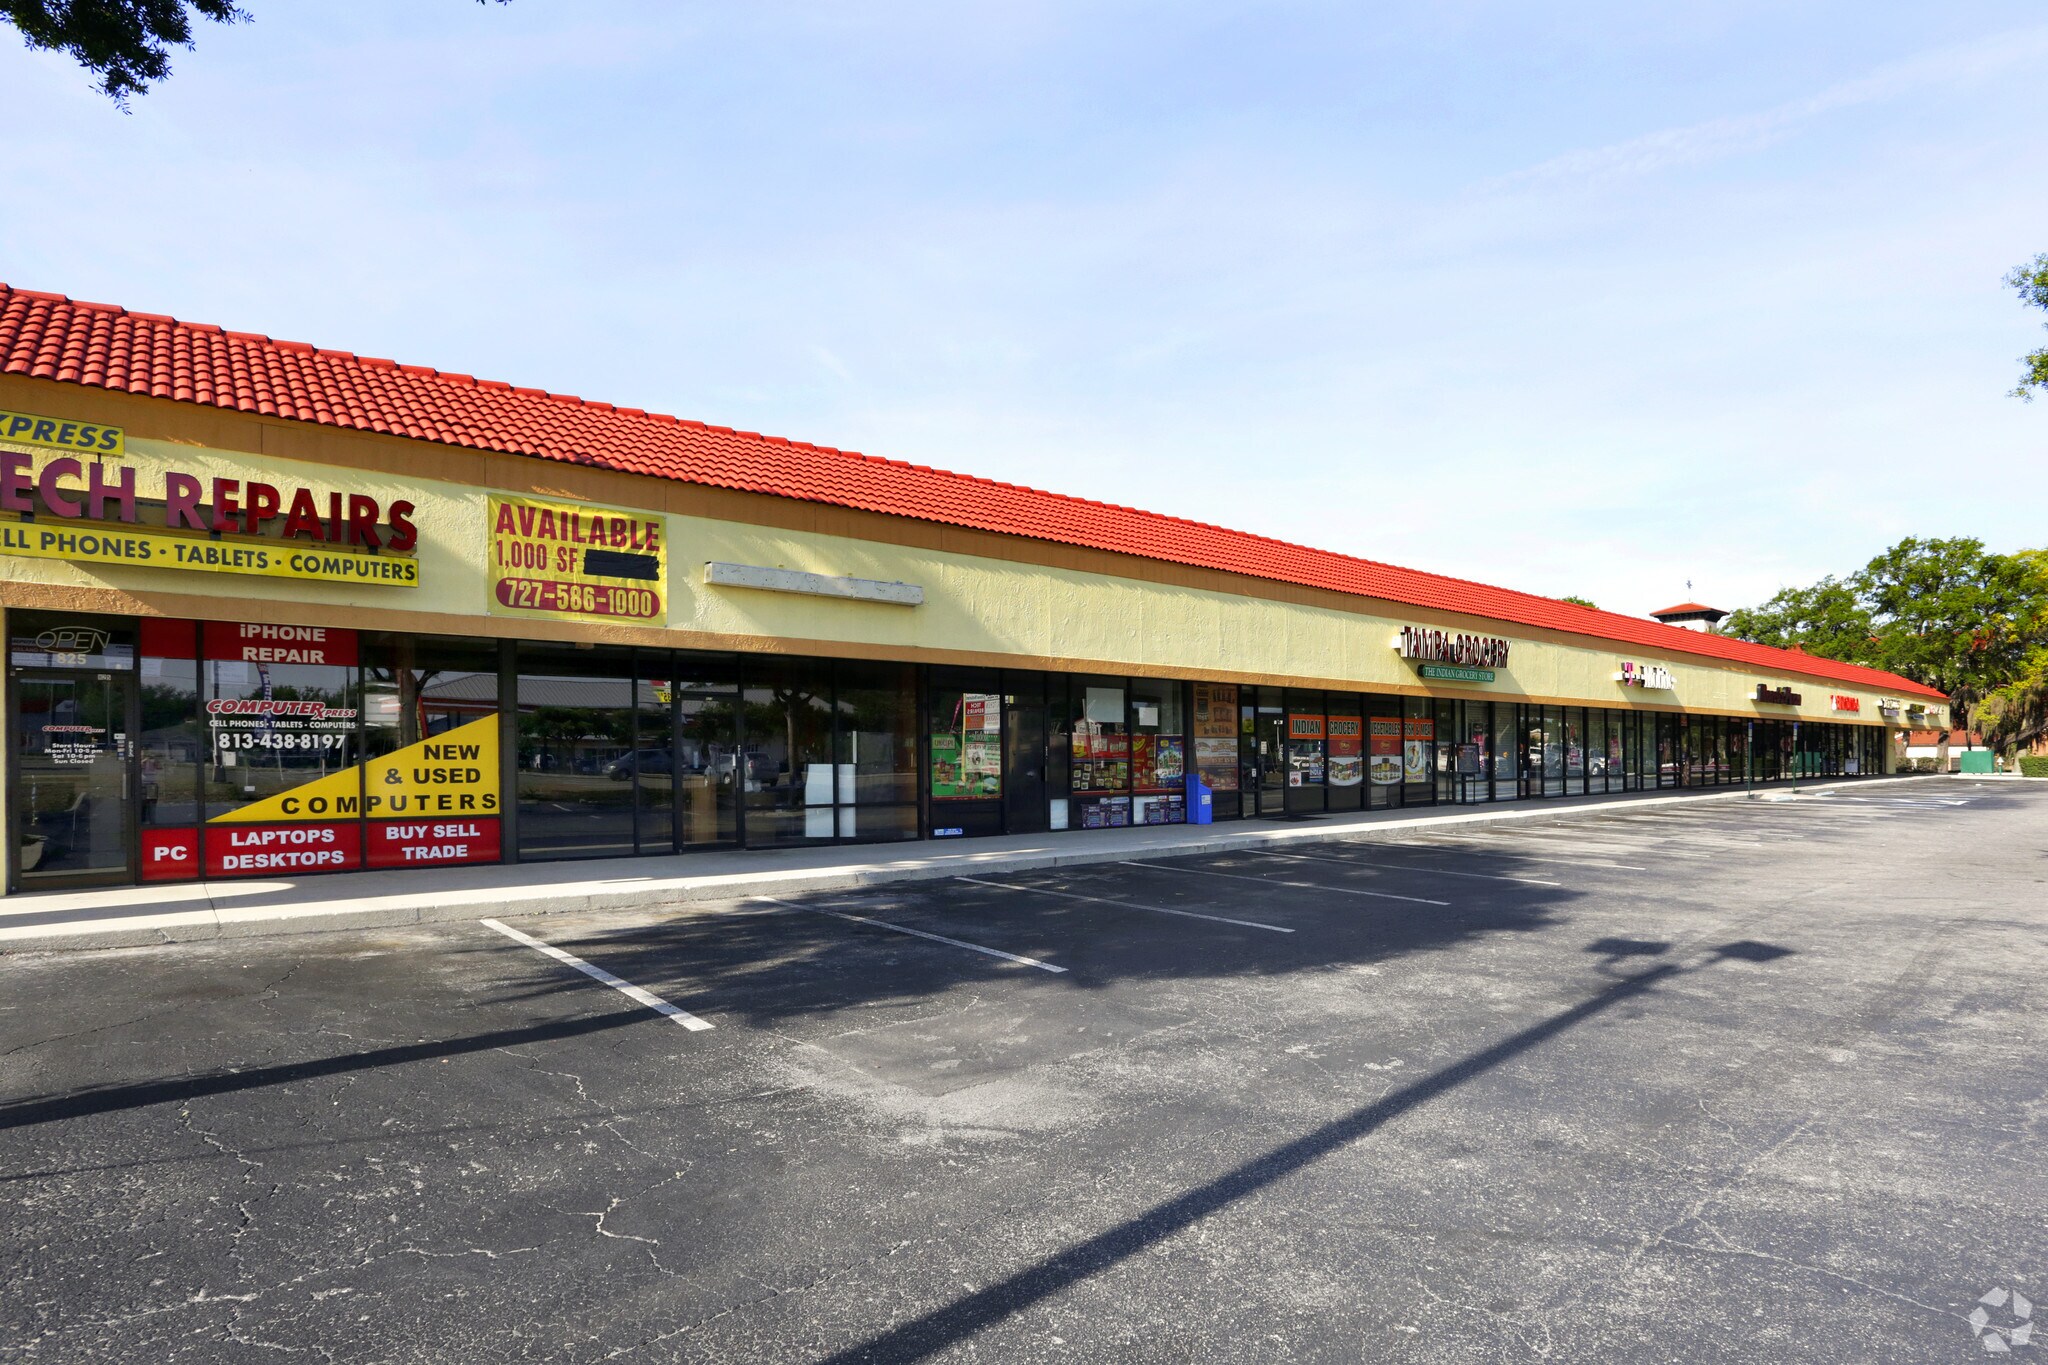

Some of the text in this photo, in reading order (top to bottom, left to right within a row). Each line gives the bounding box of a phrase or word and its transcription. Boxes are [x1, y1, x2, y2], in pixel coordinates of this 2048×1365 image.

[165, 471, 418, 551] REPAIRS
[495, 502, 660, 552] AVAILABLE
[0, 527, 416, 581] LL PHONES TABLETS COMPUTERS
[496, 540, 578, 573] 1,000 SF
[506, 579, 652, 616] 727-586-1000
[35, 631, 111, 649] OPEN
[240, 624, 326, 642] iPHONE
[242, 646, 325, 664] REPAIR
[1400, 625, 1511, 669] TAMPA GROCERY
[57, 652, 87, 665] 825
[1425, 667, 1494, 681] THE INDIAN GROCERY STORE
[229, 720, 264, 728] PHONES
[271, 721, 303, 729] TABLETS
[1292, 719, 1322, 735] INDIAN
[1328, 721, 1359, 736] GROCERY
[1371, 722, 1400, 736] VEGETABLES
[1421, 723, 1433, 736] MEAT
[219, 733, 346, 749] 813-438-8197
[424, 744, 480, 760] NEW
[384, 768, 481, 784] & USED
[281, 793, 497, 815] COMPUTERS
[231, 829, 335, 846] LAPTOPS
[386, 823, 480, 840] BUY SELL
[154, 846, 188, 861] PC
[223, 850, 345, 870] DESKTOPS
[402, 844, 468, 860] TRADE
